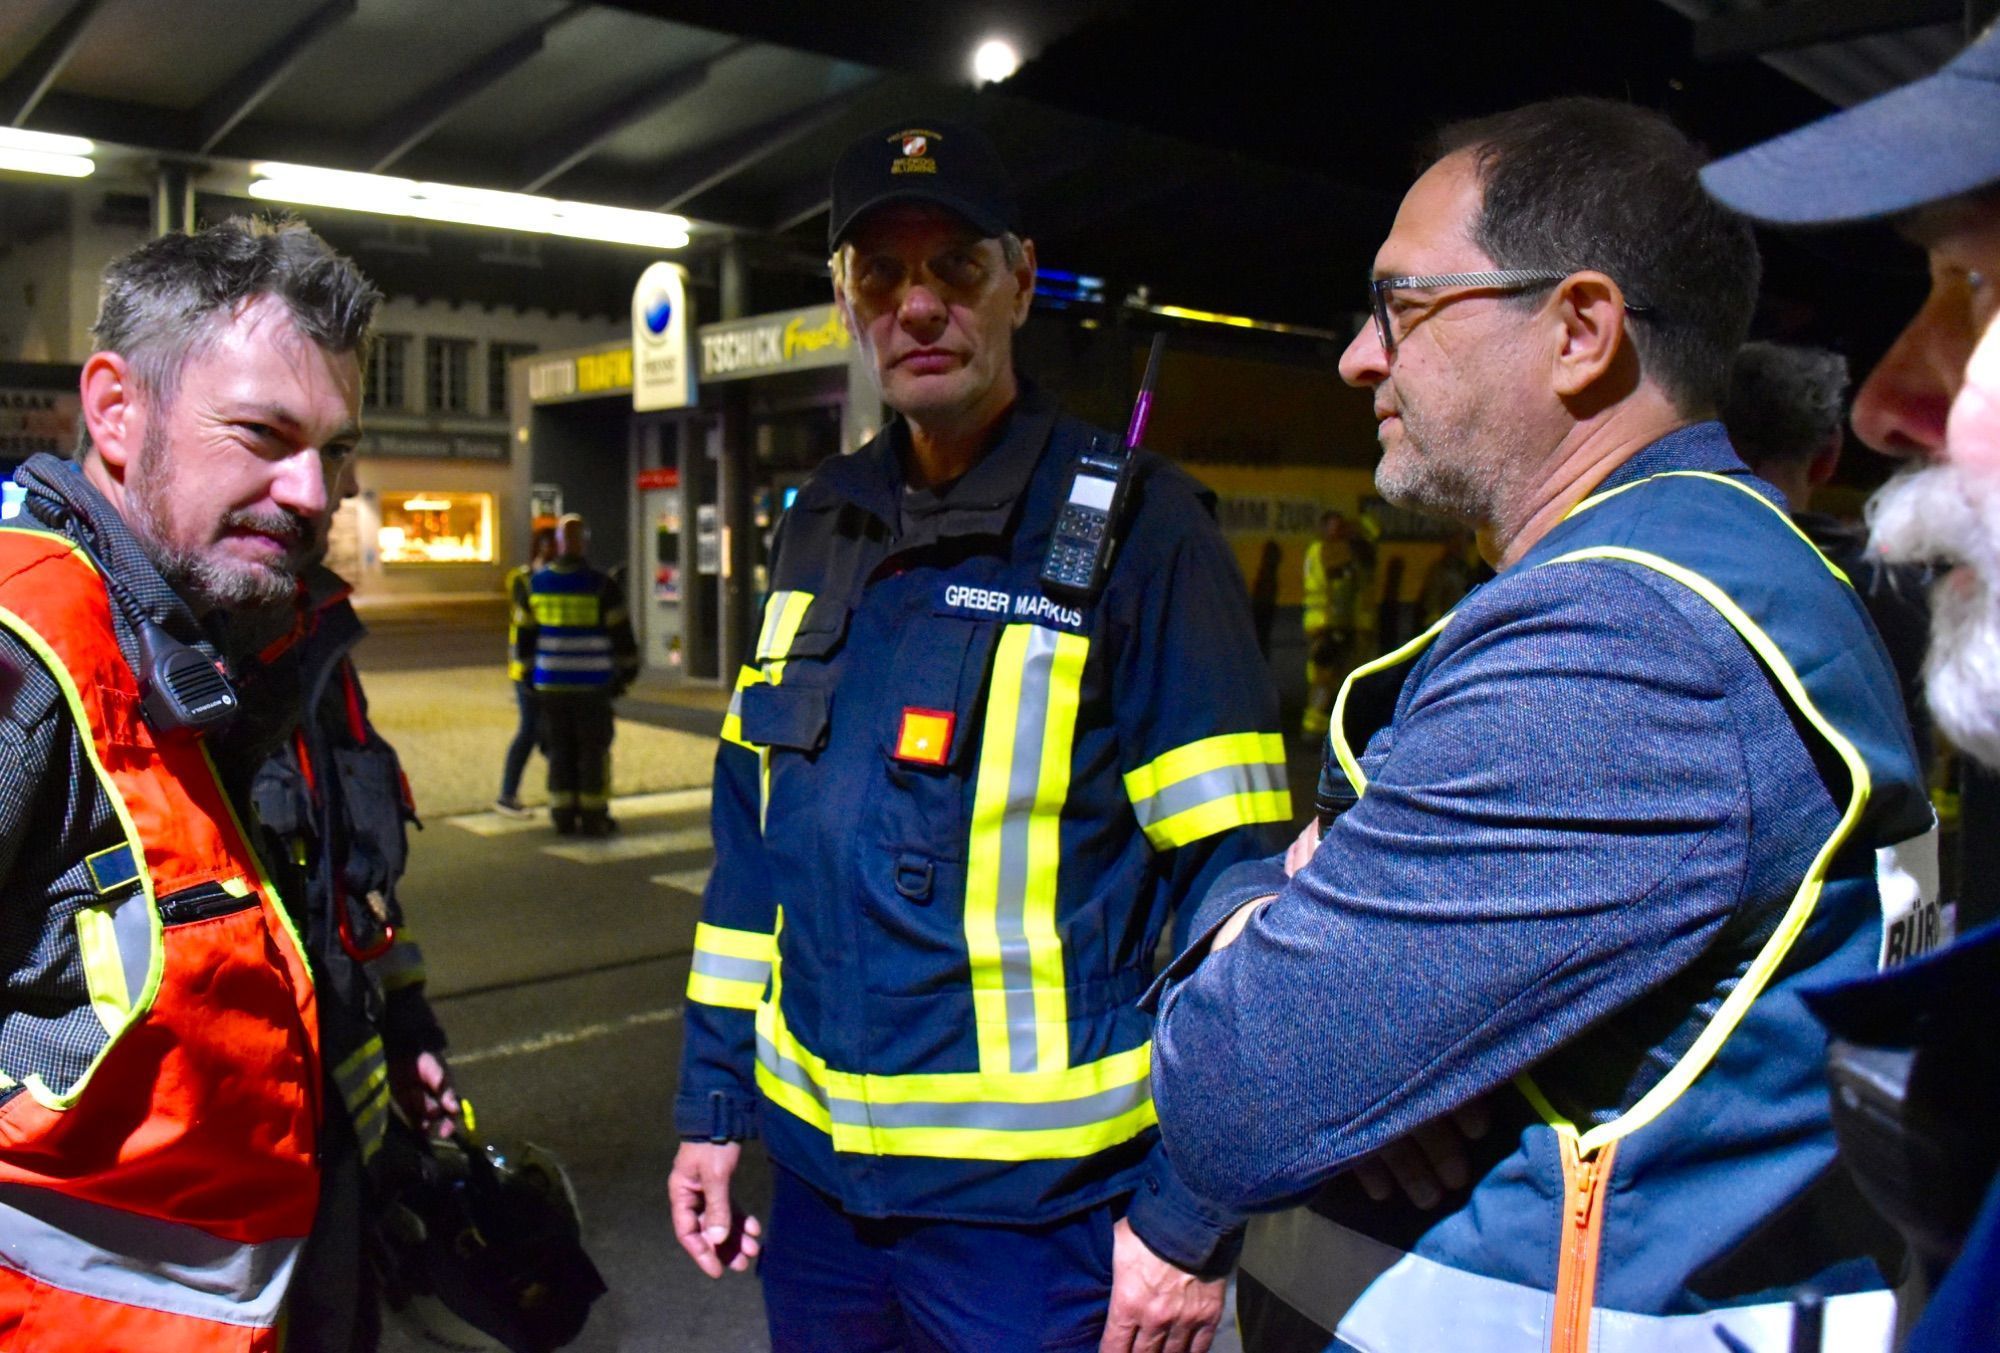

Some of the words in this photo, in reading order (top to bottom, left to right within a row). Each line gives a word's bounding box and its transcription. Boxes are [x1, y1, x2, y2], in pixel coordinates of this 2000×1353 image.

[701, 325, 783, 375] TSCHICK
[945, 585, 1010, 614] GREBER
[1014, 594, 1083, 627] MARKUS
